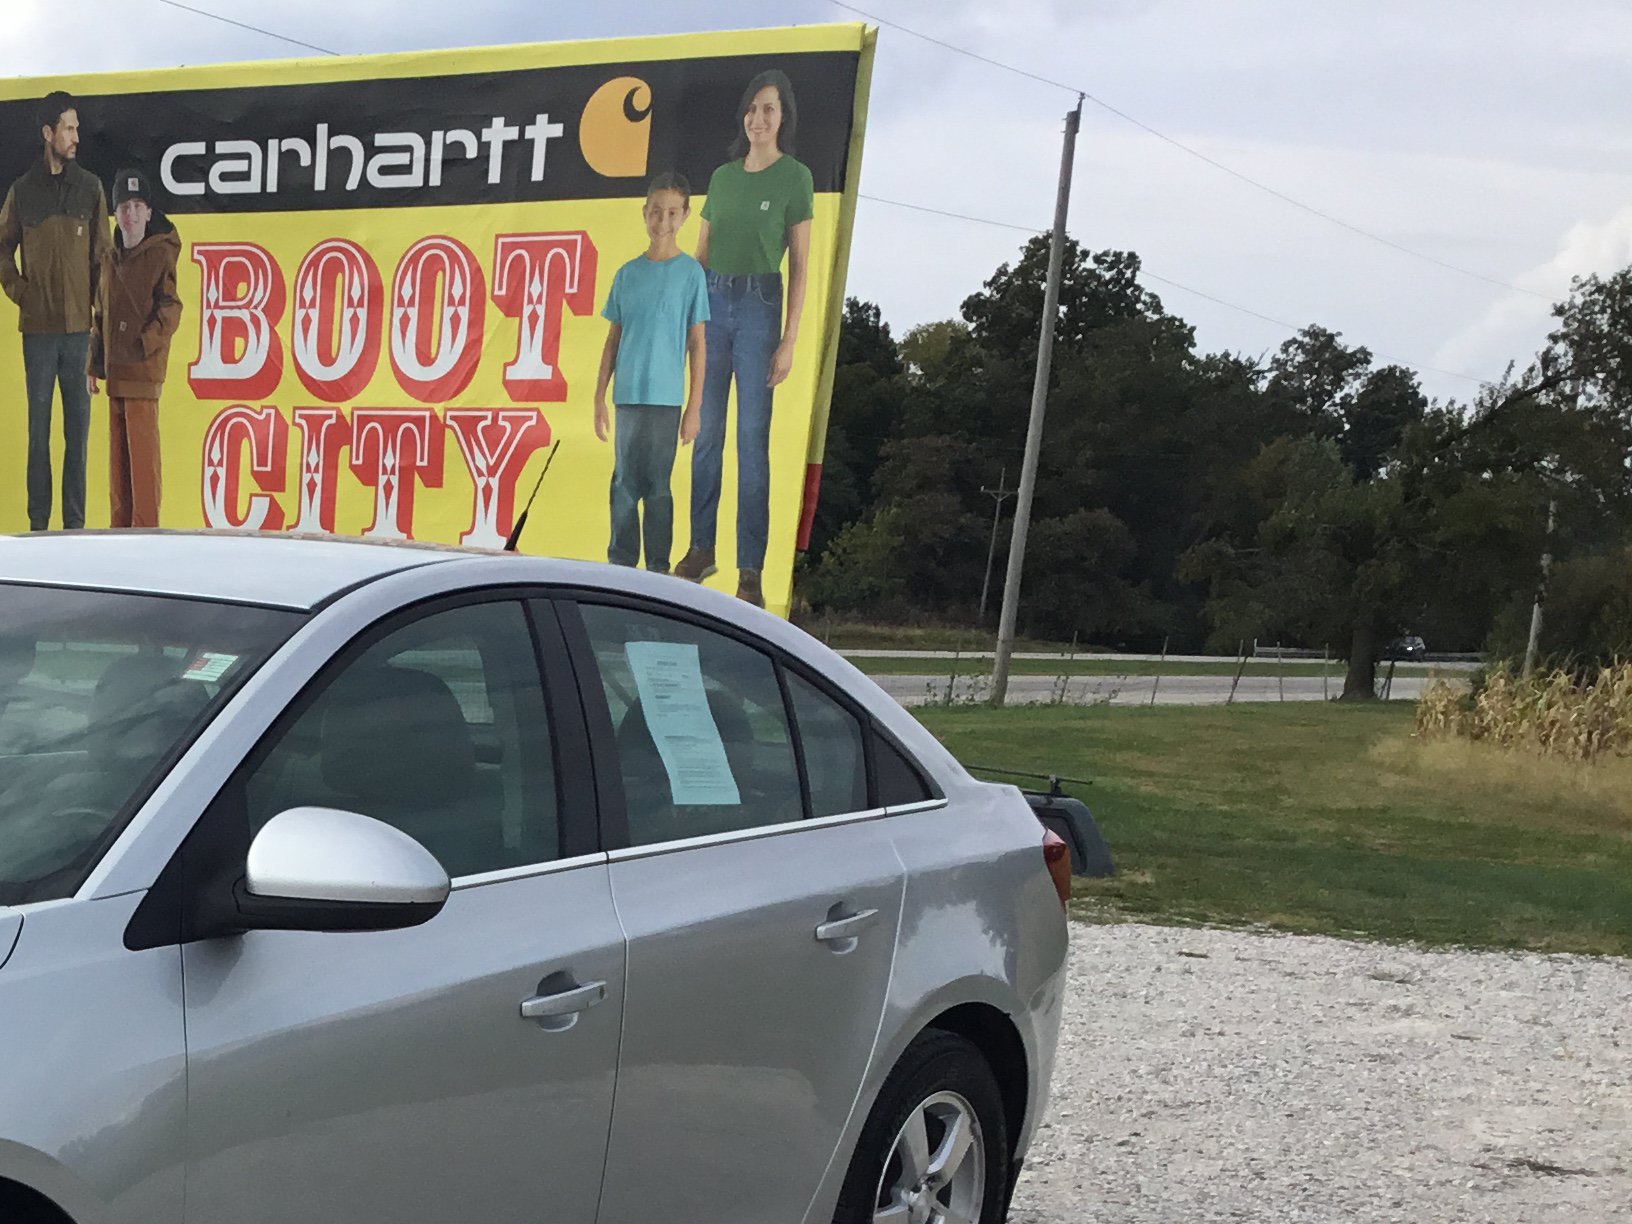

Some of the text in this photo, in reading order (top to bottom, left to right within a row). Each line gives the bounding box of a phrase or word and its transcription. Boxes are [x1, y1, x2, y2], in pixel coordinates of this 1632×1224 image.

[160, 113, 564, 196] carhartt
[187, 230, 598, 403] BOOT
[201, 404, 551, 551] CITY
